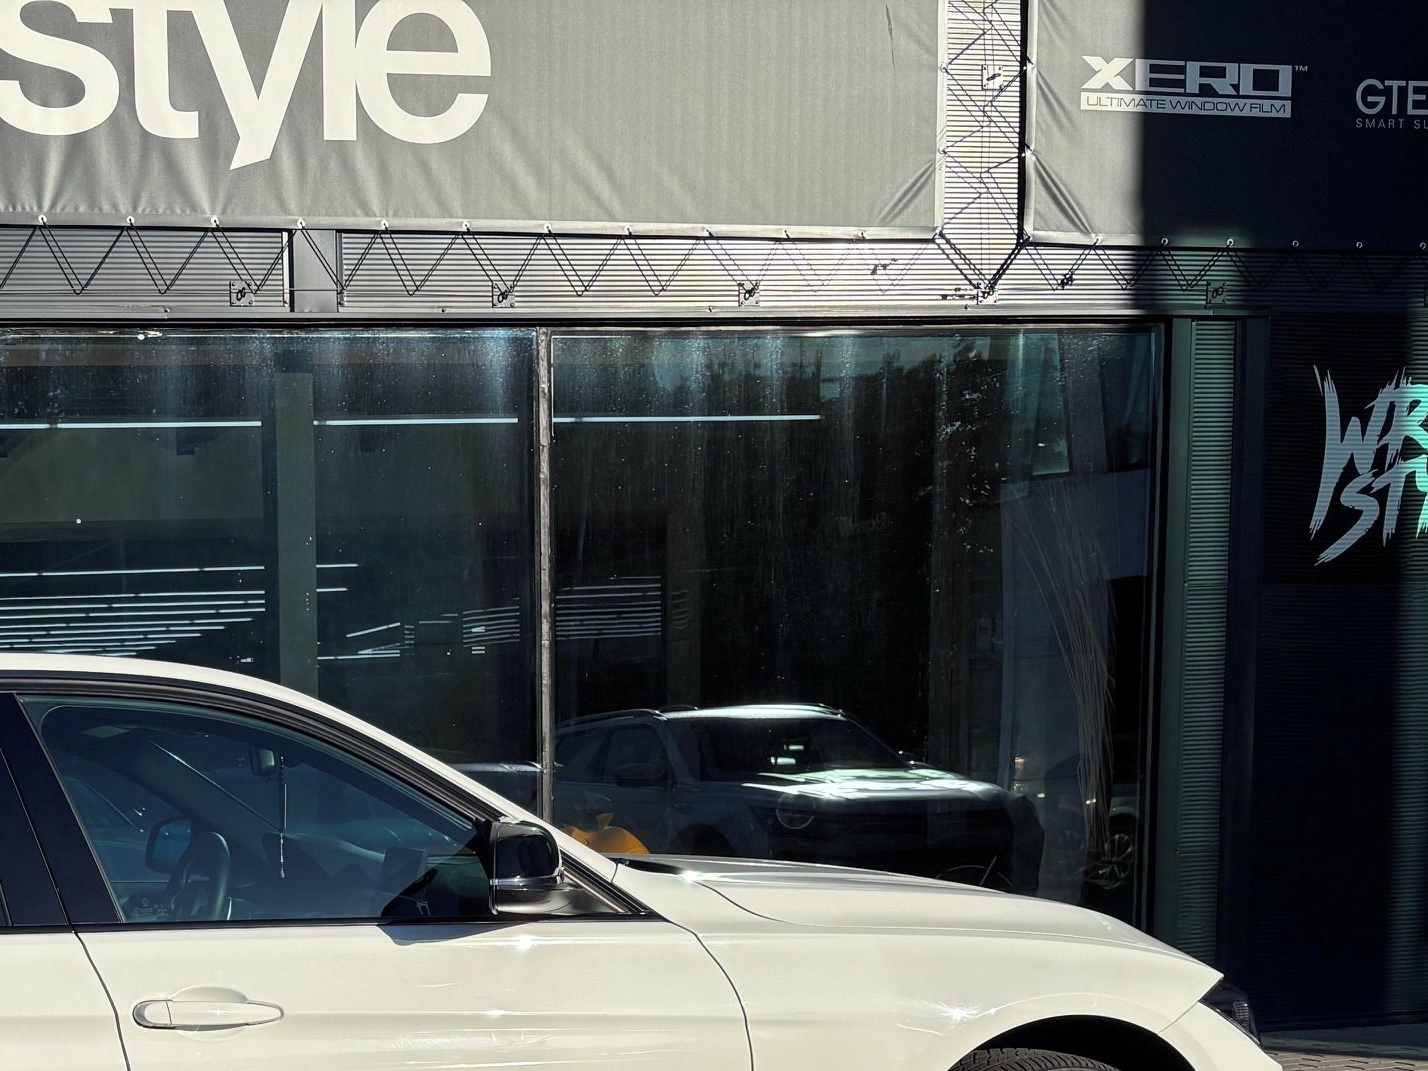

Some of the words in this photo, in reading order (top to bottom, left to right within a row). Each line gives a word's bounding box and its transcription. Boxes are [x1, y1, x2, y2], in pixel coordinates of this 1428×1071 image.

[1080, 55, 1293, 98] XERO
[1085, 95, 1167, 110] ULTIMATE
[1168, 99, 1247, 113] WINDOW
[1249, 102, 1287, 115] FILM
[1356, 78, 1428, 115] GTE
[1356, 117, 1405, 129] SMART
